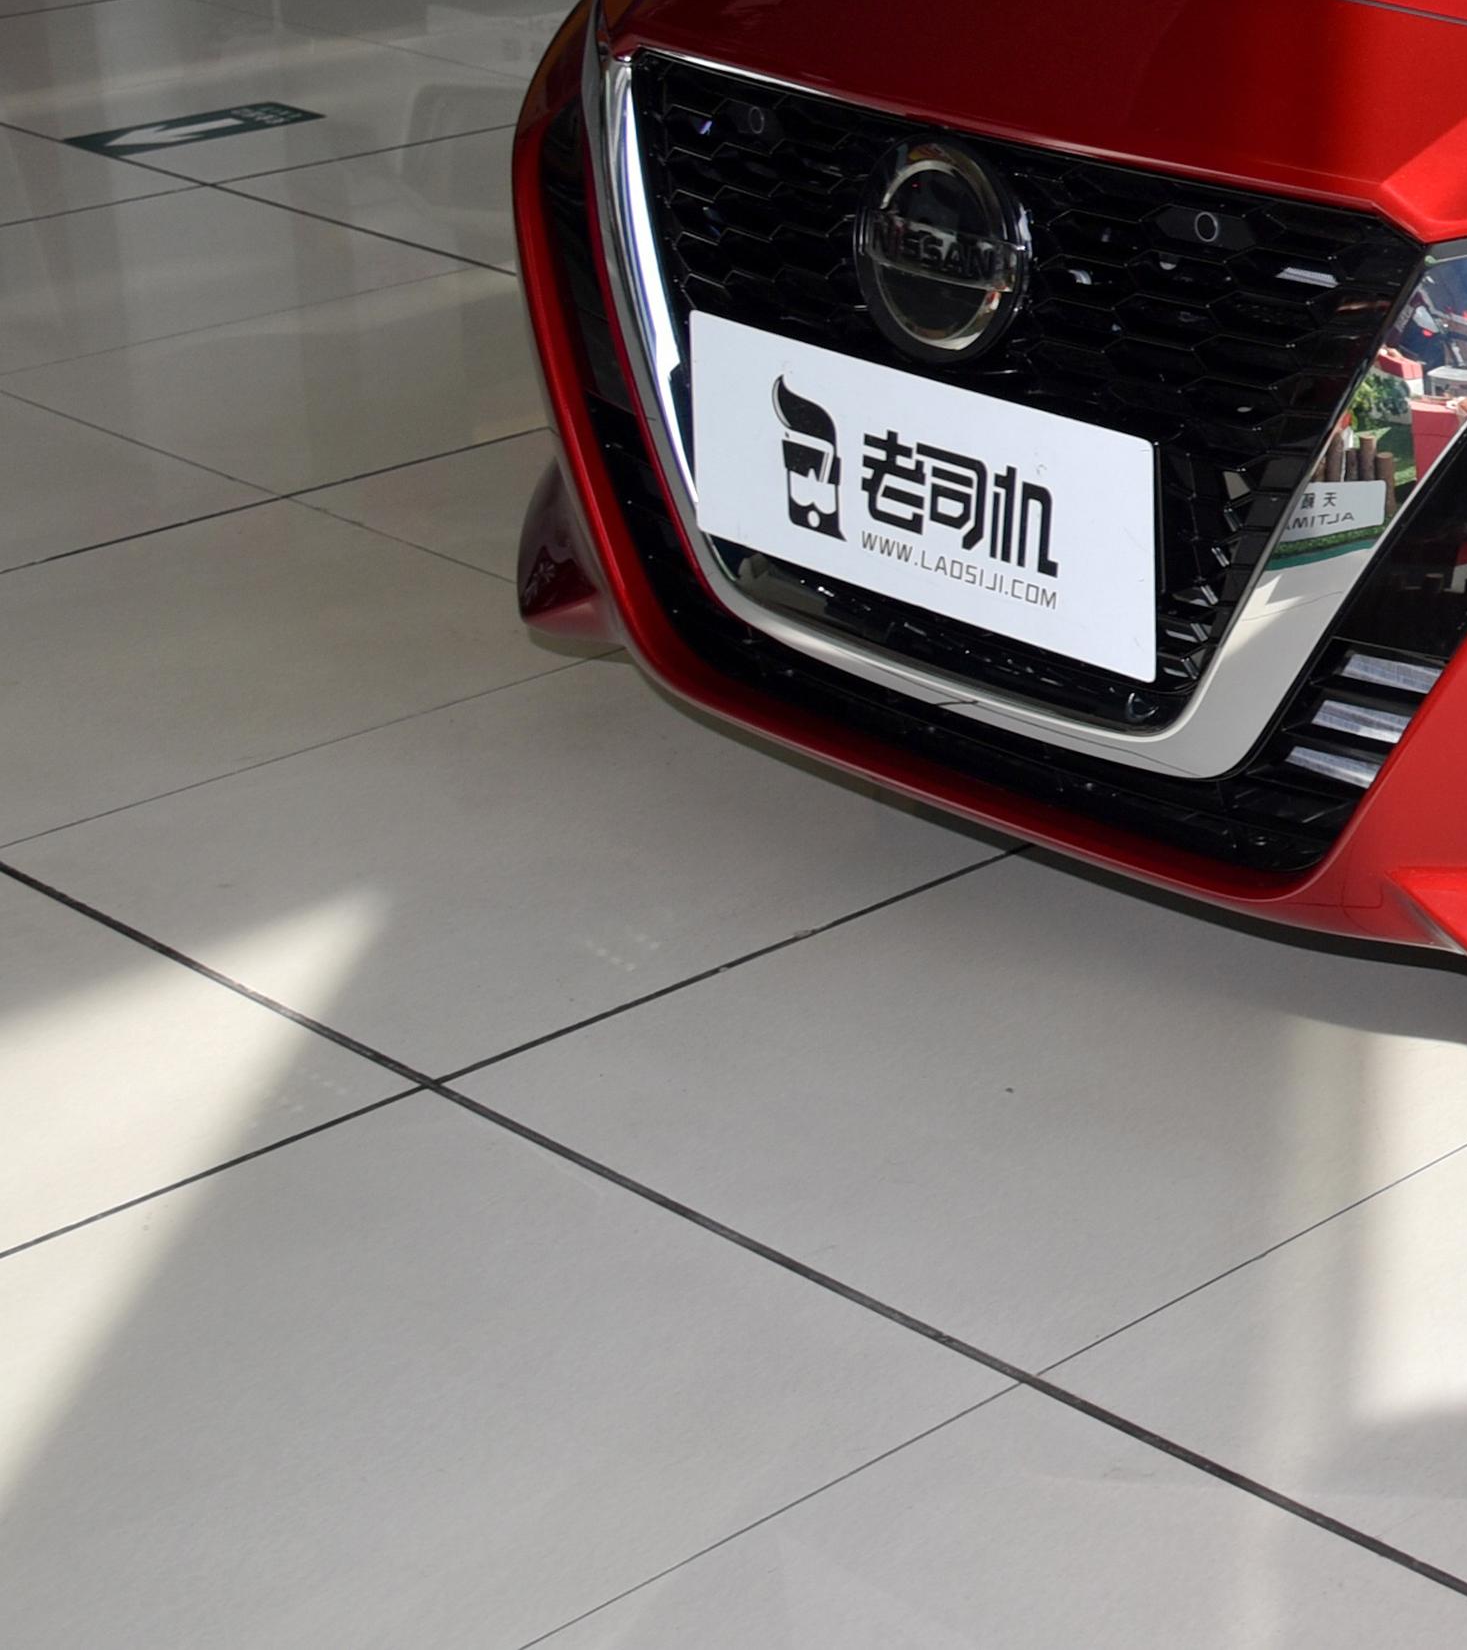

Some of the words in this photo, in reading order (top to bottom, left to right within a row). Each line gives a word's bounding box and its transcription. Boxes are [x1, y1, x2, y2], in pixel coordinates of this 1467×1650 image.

[860, 429, 1059, 578] 老司机
[860, 530, 1058, 610] WWW.LAOSIJI.COM
